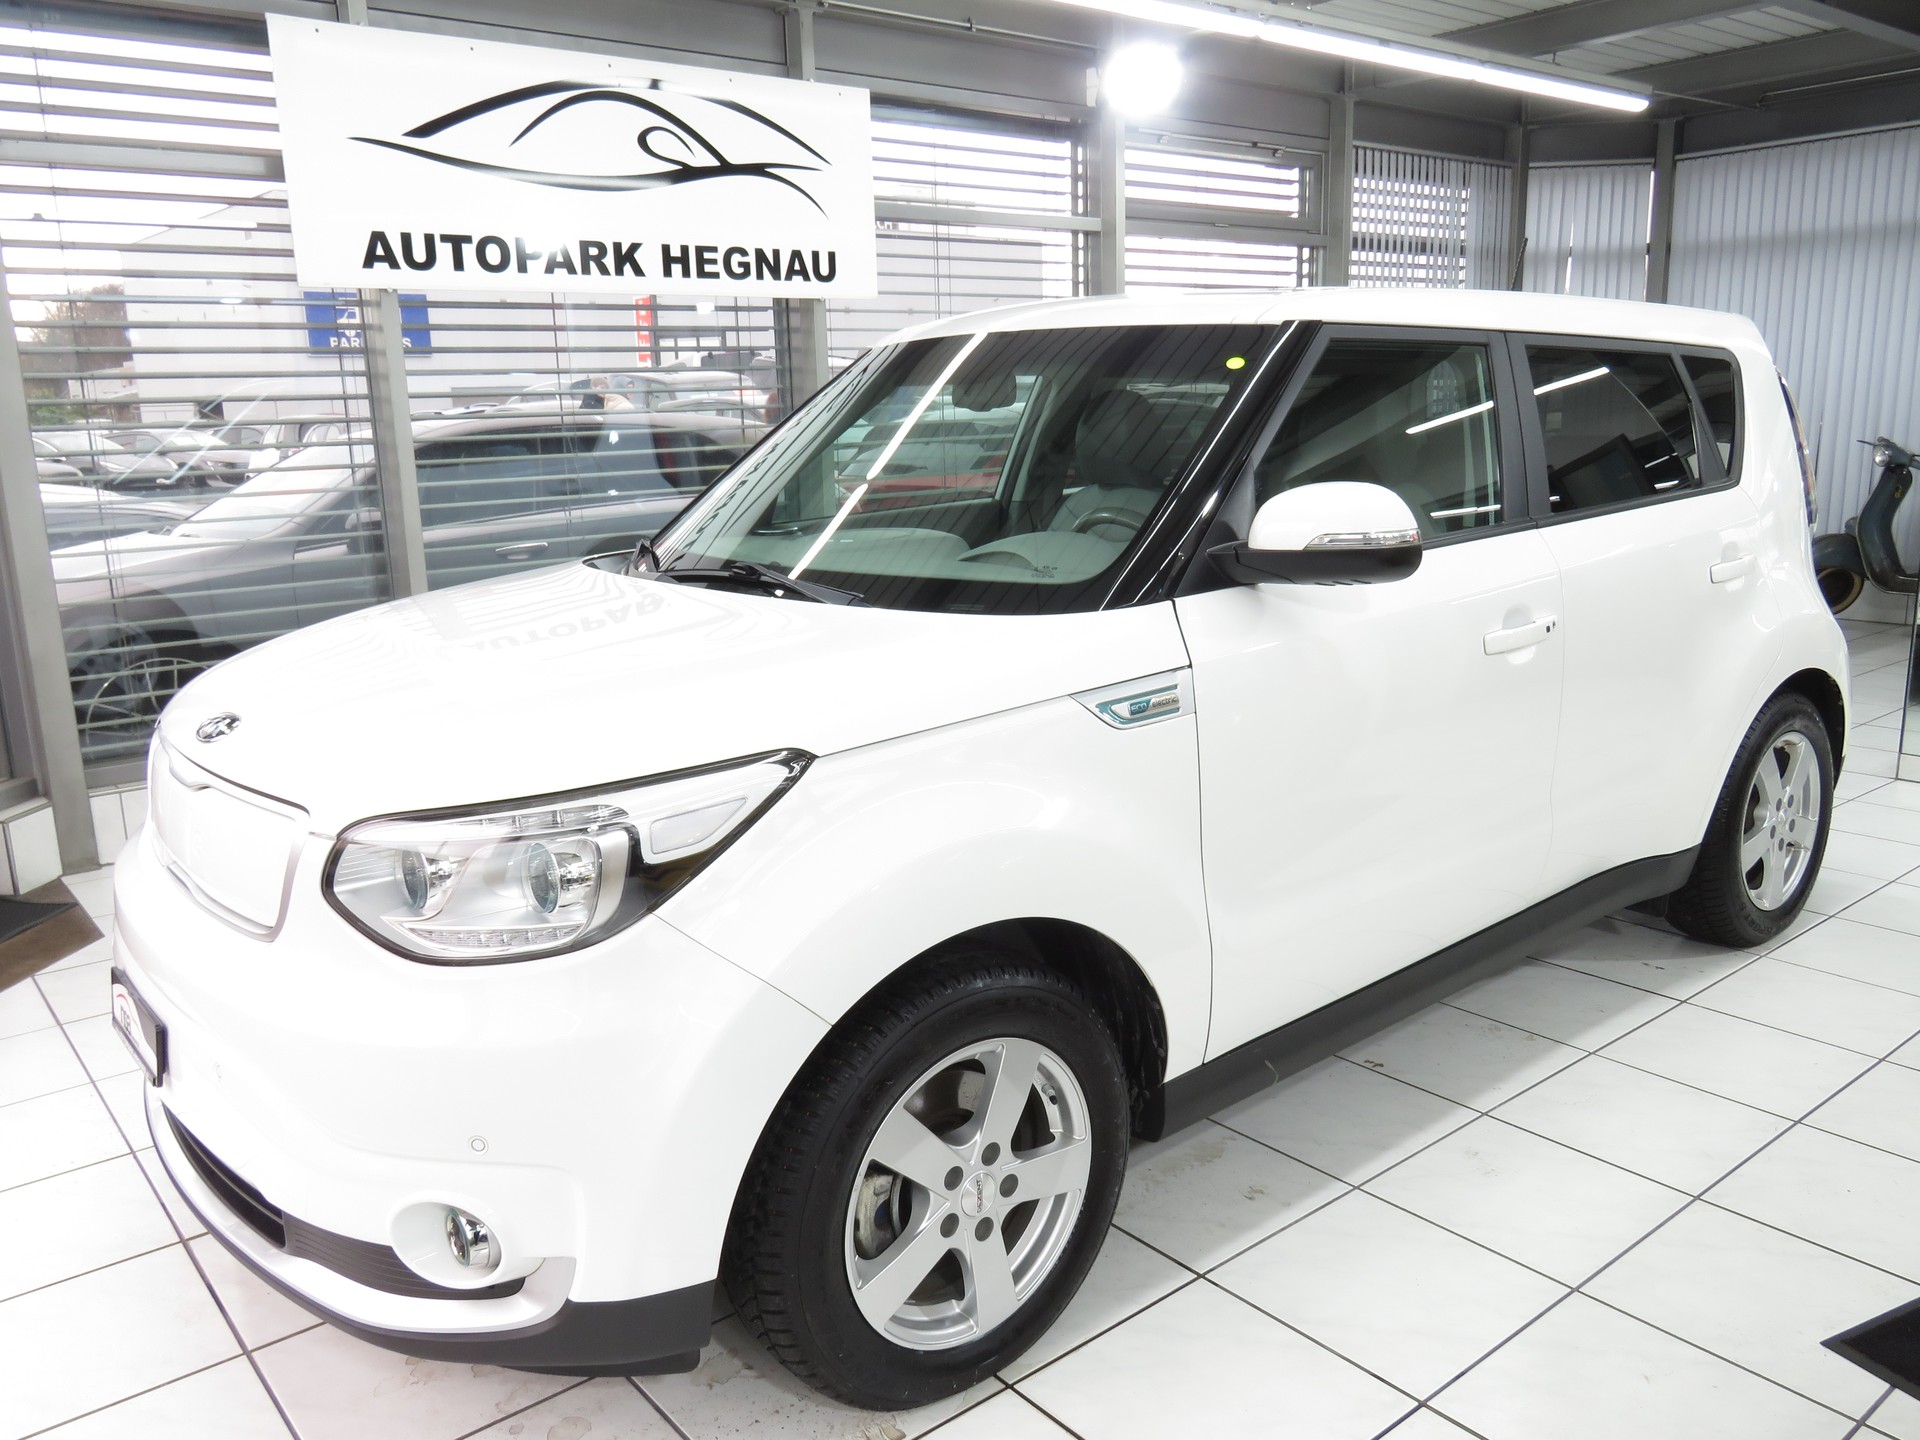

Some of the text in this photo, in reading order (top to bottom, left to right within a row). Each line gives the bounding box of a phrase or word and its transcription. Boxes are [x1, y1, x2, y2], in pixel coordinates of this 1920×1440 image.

[362, 230, 836, 283] AUTOPARK HEGNAU
[1130, 694, 1177, 713] ECO electric
